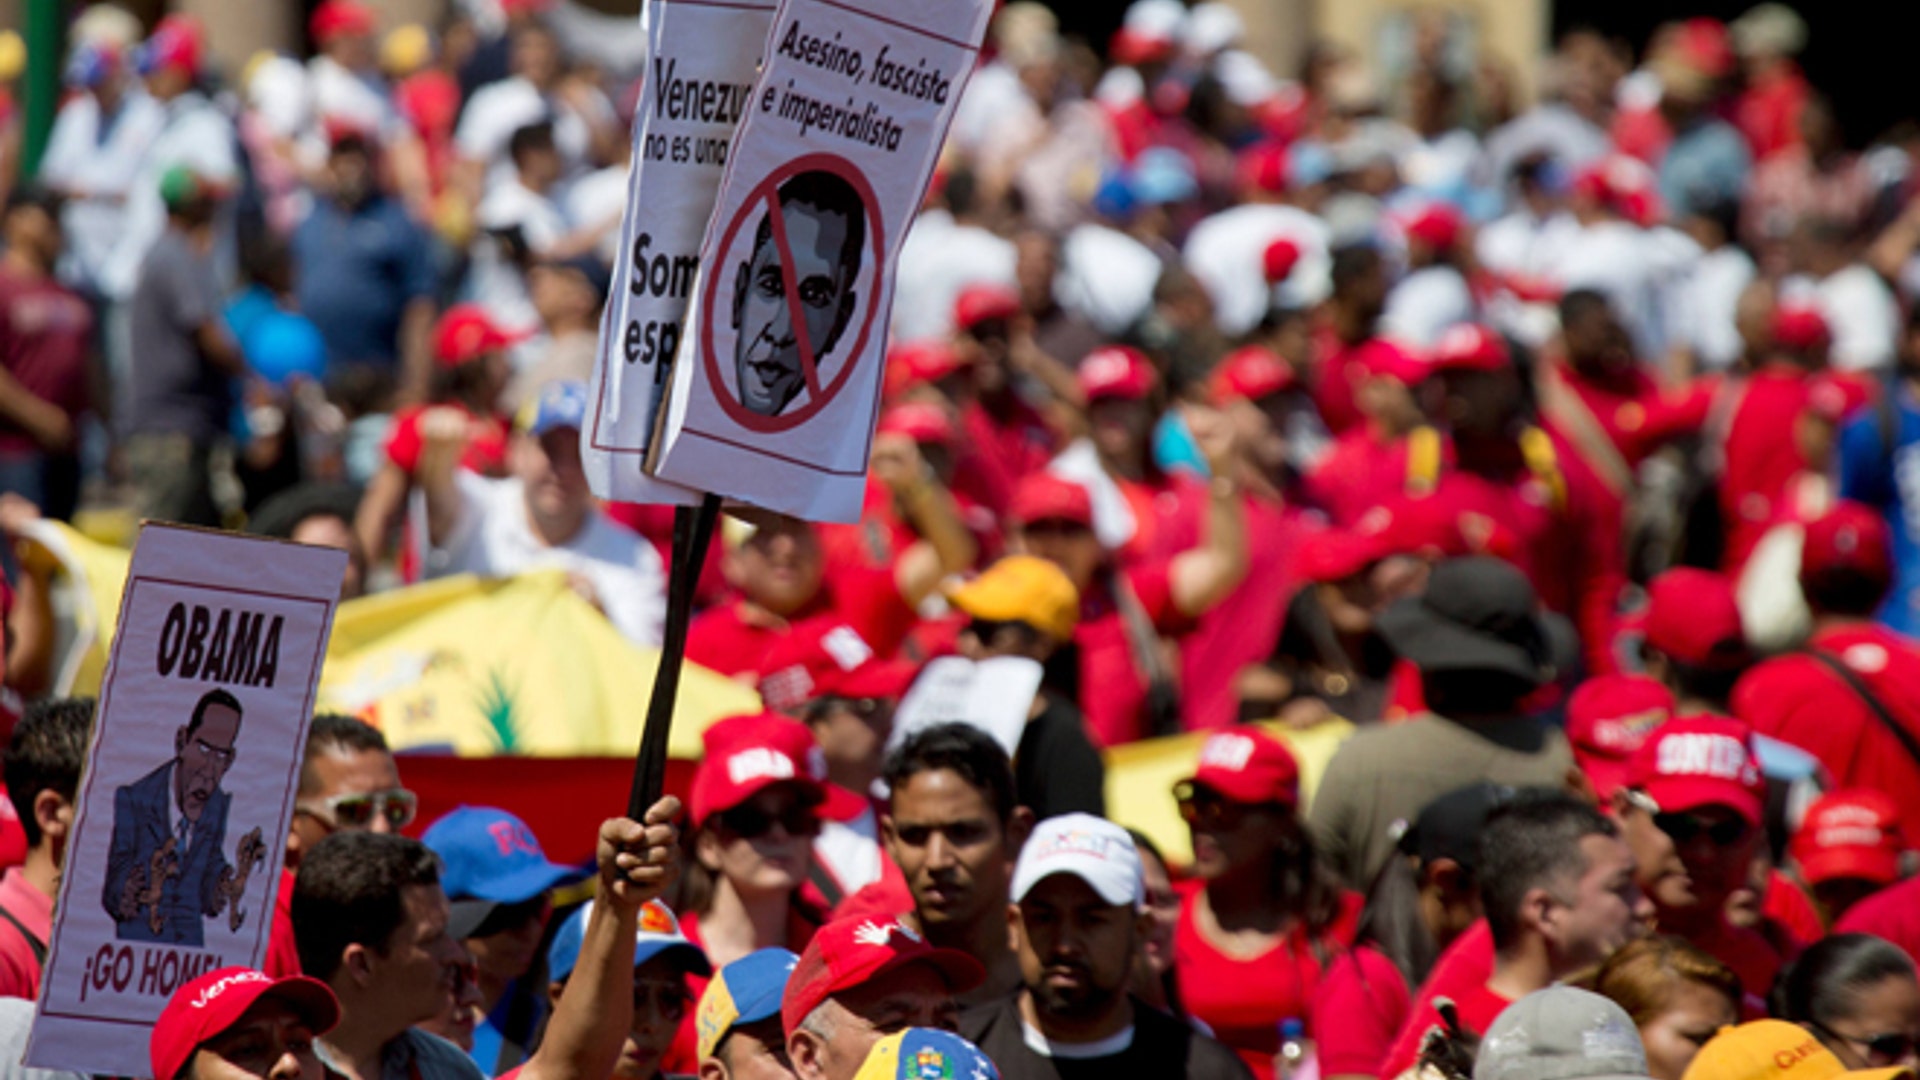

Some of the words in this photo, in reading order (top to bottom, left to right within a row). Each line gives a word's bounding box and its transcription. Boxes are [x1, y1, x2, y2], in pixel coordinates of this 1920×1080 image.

[778, 20, 865, 85] Asesino,
[869, 44, 950, 105] fascista
[643, 133, 667, 161] no
[671, 136, 691, 162] es
[761, 86, 775, 112] e
[778, 78, 903, 151] imperialista
[157, 601, 285, 688] OBAMA
[79, 943, 134, 1002] ¡GO
